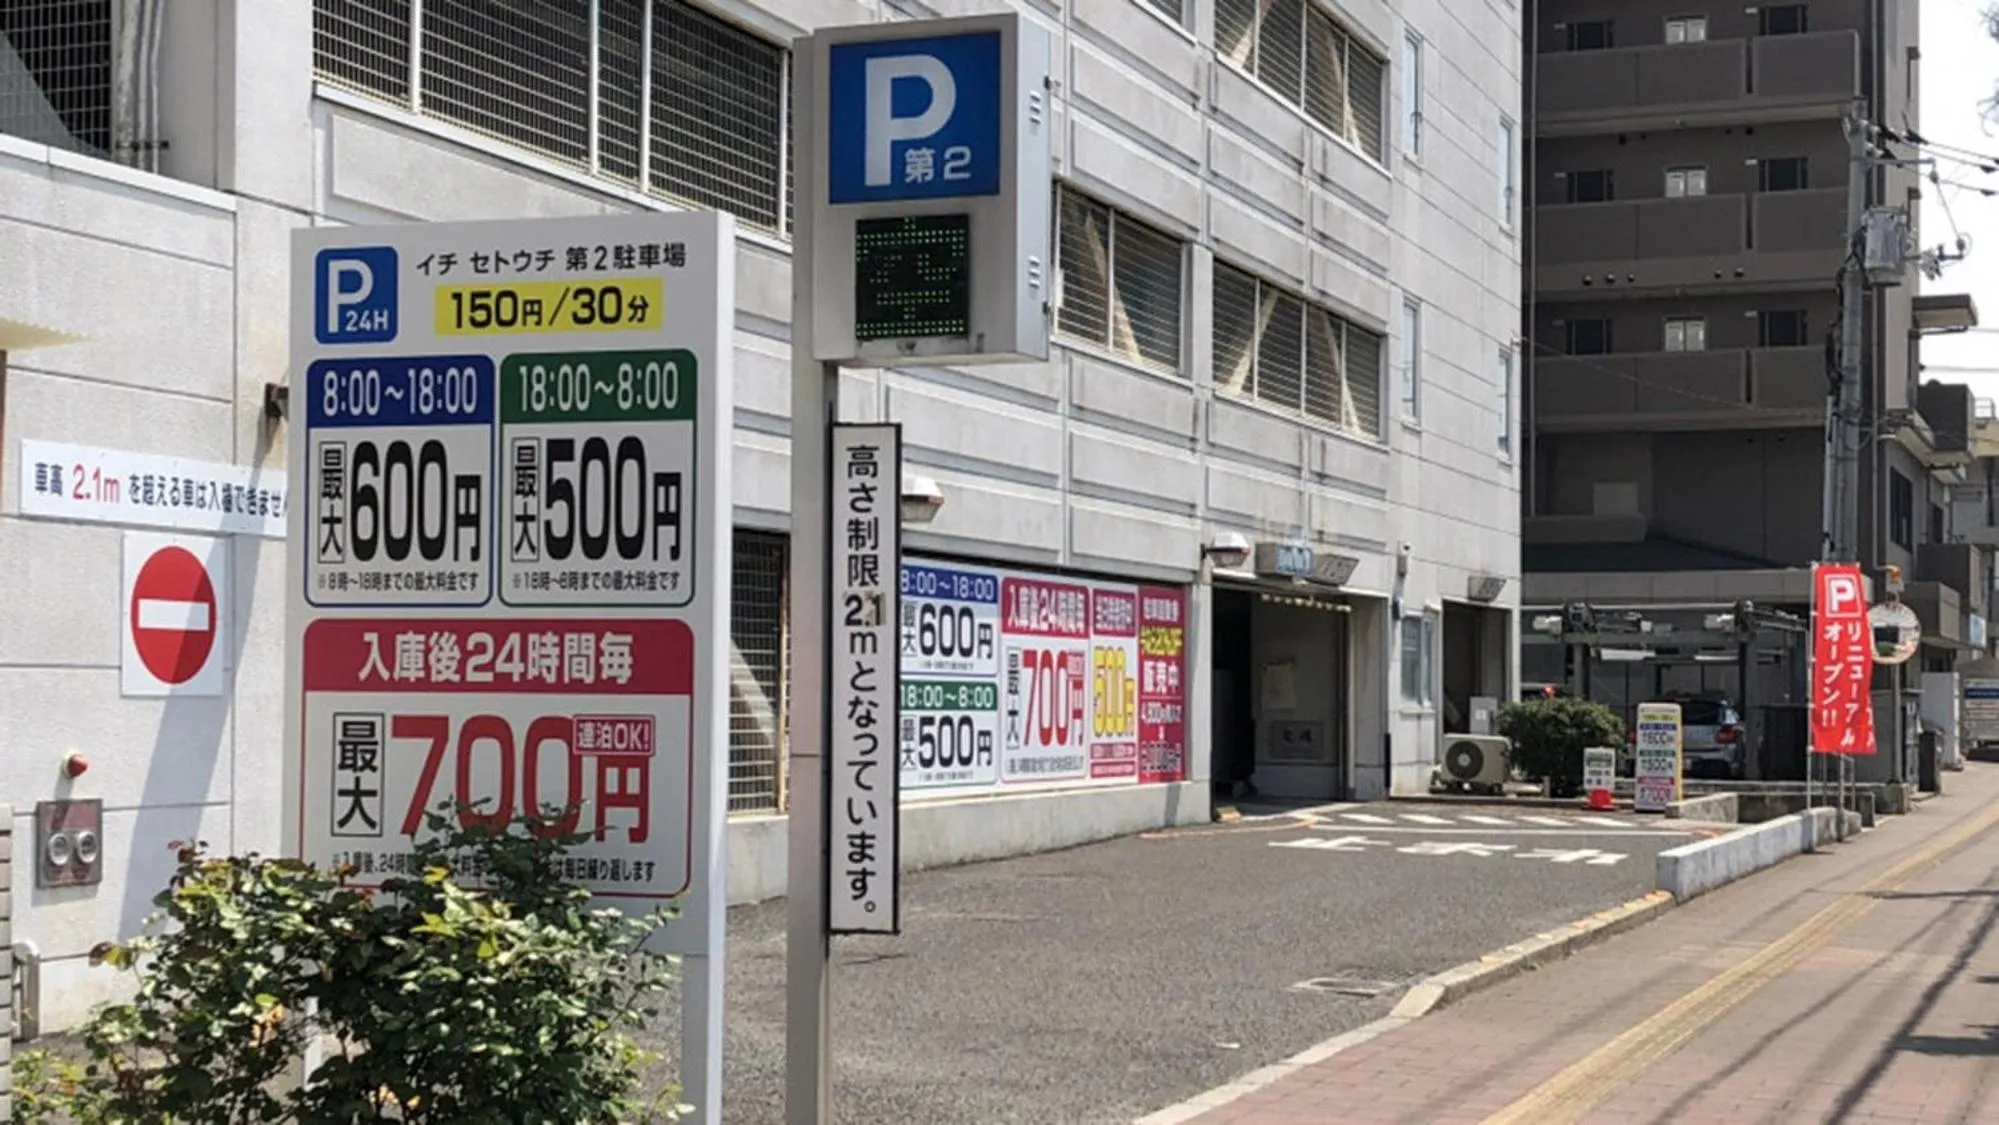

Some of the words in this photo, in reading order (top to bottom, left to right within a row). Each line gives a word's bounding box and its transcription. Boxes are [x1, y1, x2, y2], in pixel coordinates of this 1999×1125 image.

[866, 54, 956, 186] P
[905, 146, 971, 183] 第2
[416, 252, 458, 277] イチ
[470, 247, 556, 274] セトウチ
[328, 259, 373, 333] P
[346, 308, 389, 331] 24H
[451, 285, 650, 330] 150円/30分
[34, 462, 64, 497] 車高
[71, 463, 121, 504] 2.1m
[319, 448, 345, 558] 最大
[350, 440, 482, 563] 600円
[514, 444, 540, 558] 最大
[543, 436, 683, 562] 500円
[1829, 578, 1856, 612] P
[358, 630, 634, 685] 入庫後24時間毎
[920, 602, 993, 659] 600円
[1022, 648, 1086, 747] 700円
[1841, 622, 1866, 747] リニューアル
[918, 714, 993, 768] 500円
[336, 719, 379, 831] 最大
[390, 713, 651, 845] 700円
